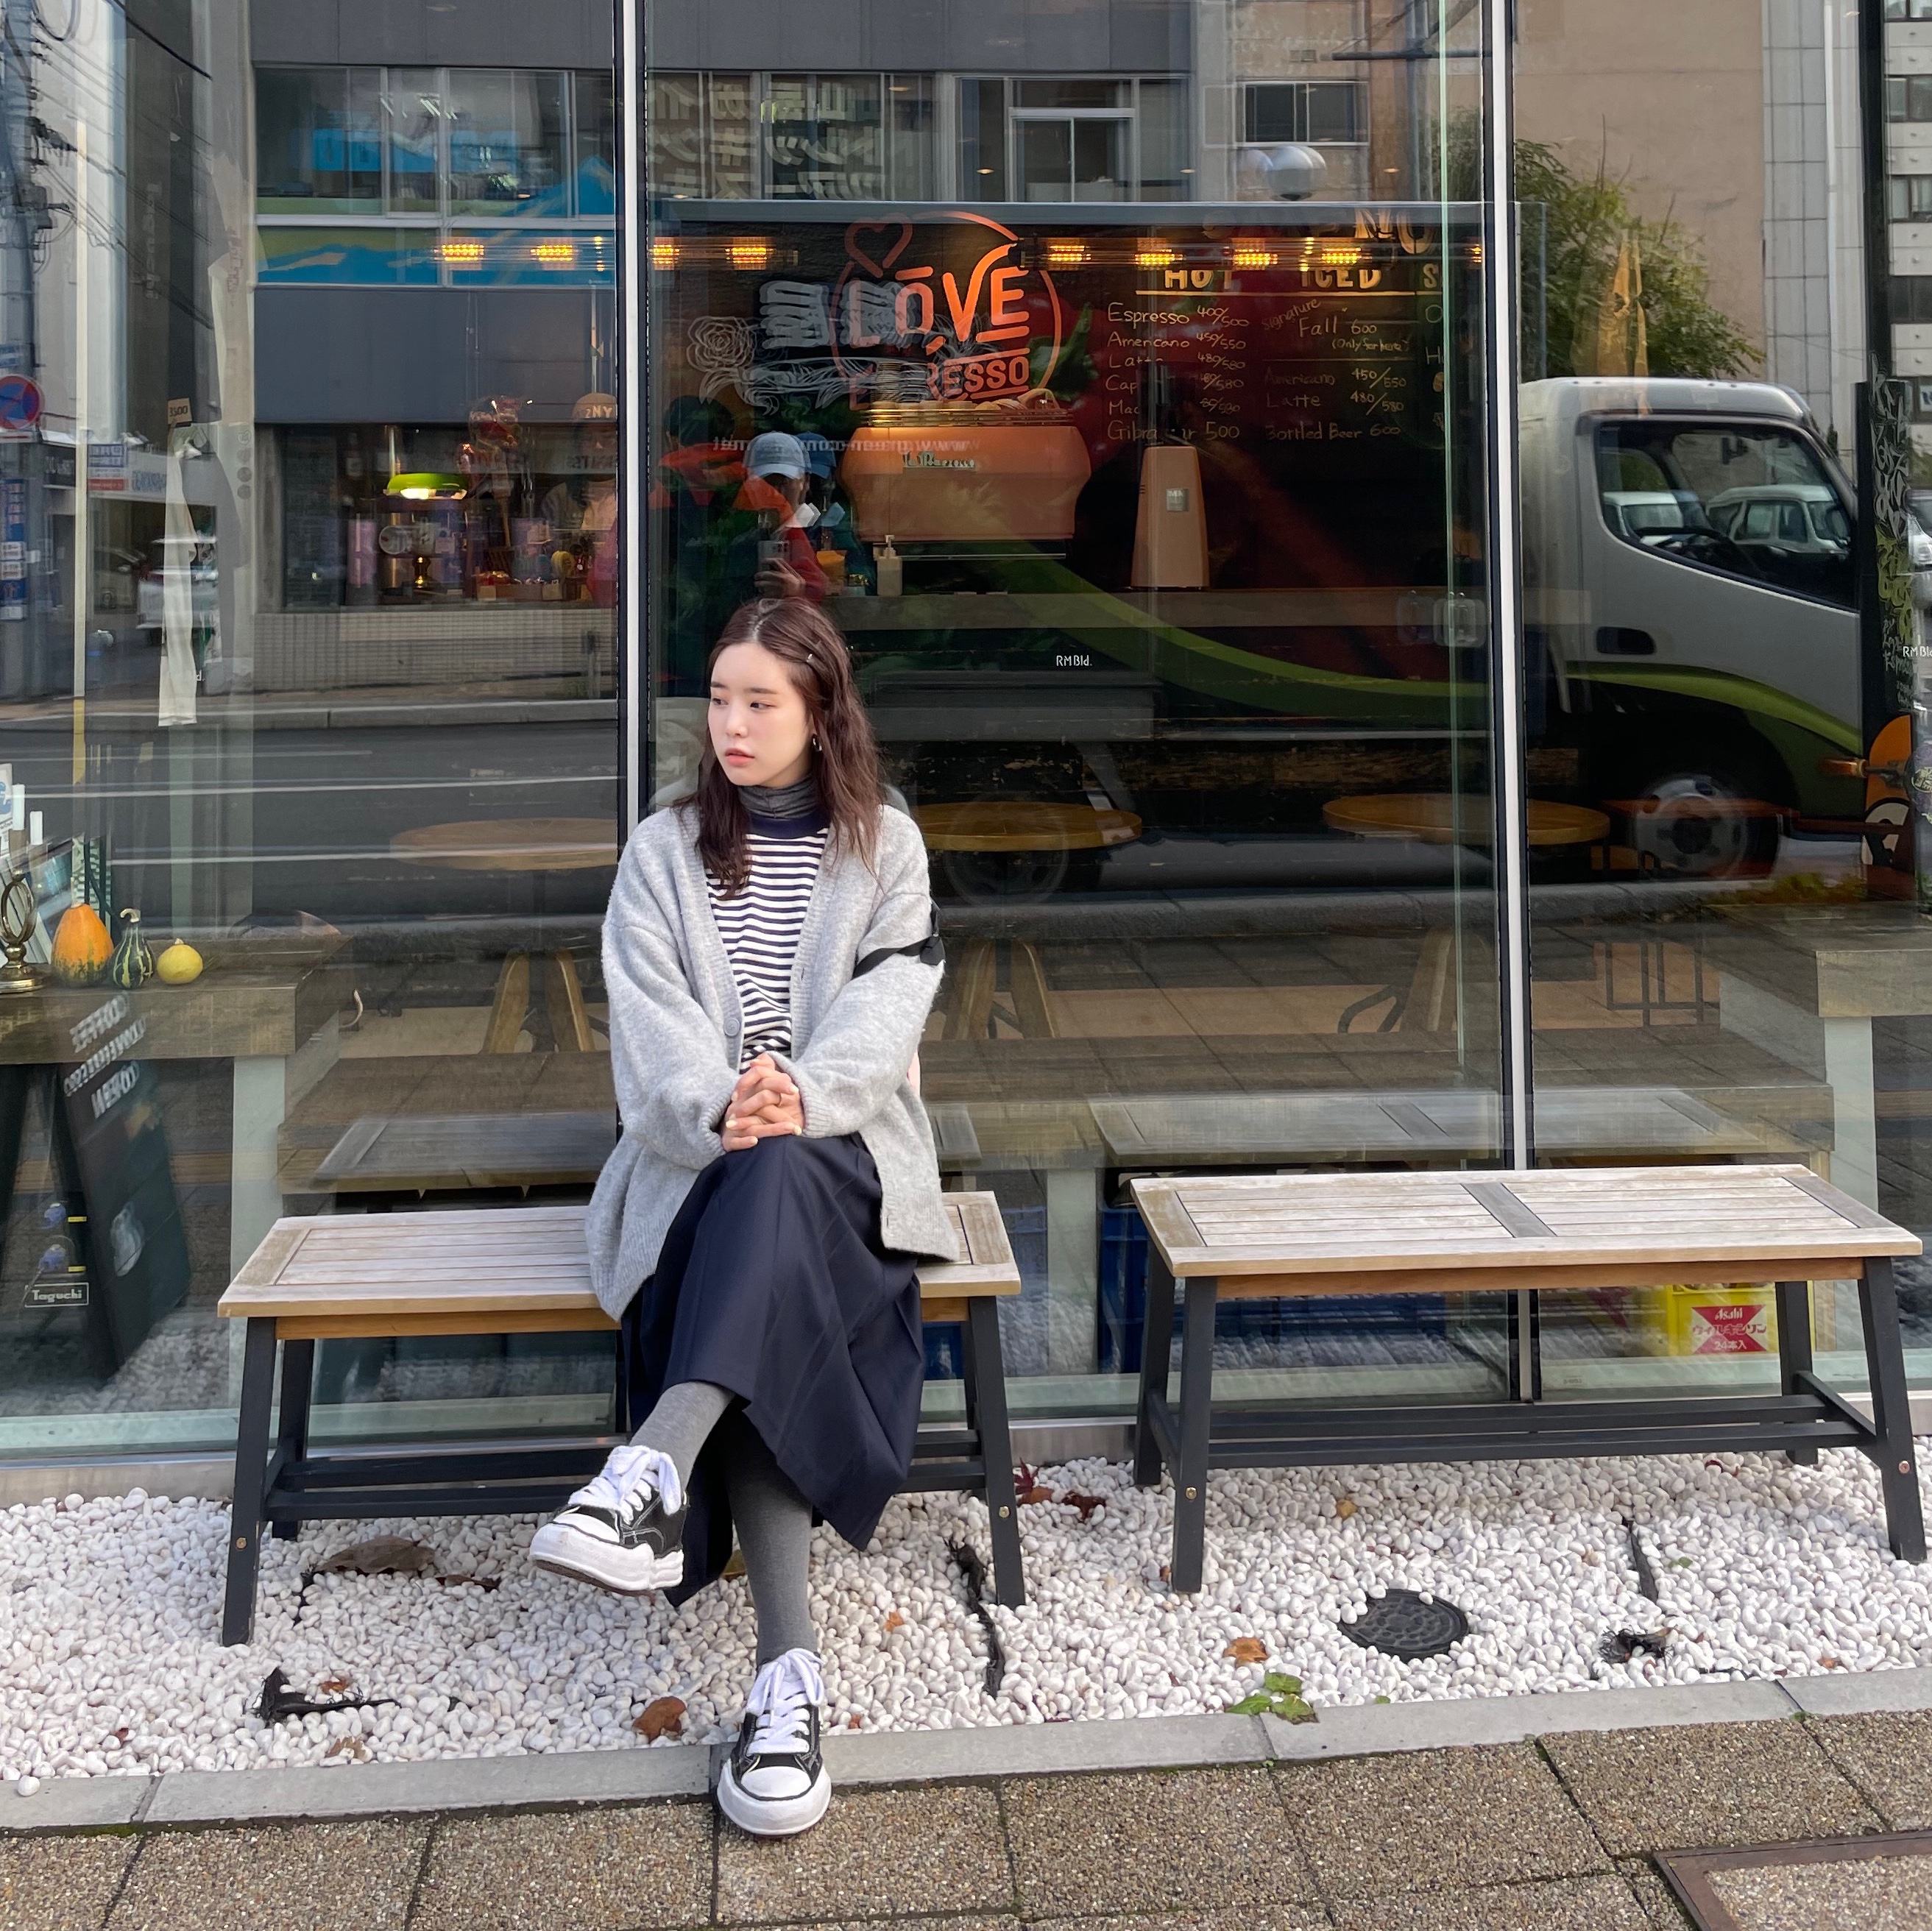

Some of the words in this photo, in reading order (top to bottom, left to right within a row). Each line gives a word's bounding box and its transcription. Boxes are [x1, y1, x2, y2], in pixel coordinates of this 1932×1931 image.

[1107, 301, 1191, 330] Espresso
[1197, 305, 1250, 328] 400/500
[1299, 315, 1337, 338] Fall
[1351, 318, 1378, 335] 600
[1106, 330, 1191, 348] Americano
[849, 356, 1030, 411] ERESSO
[1266, 392, 1322, 409] Latte
[1205, 420, 1241, 442] 500
[32, 1288, 82, 1303] Taguchi
[1714, 1306, 1744, 1321] Asahi
[1713, 1339, 1747, 1352] 24本入
